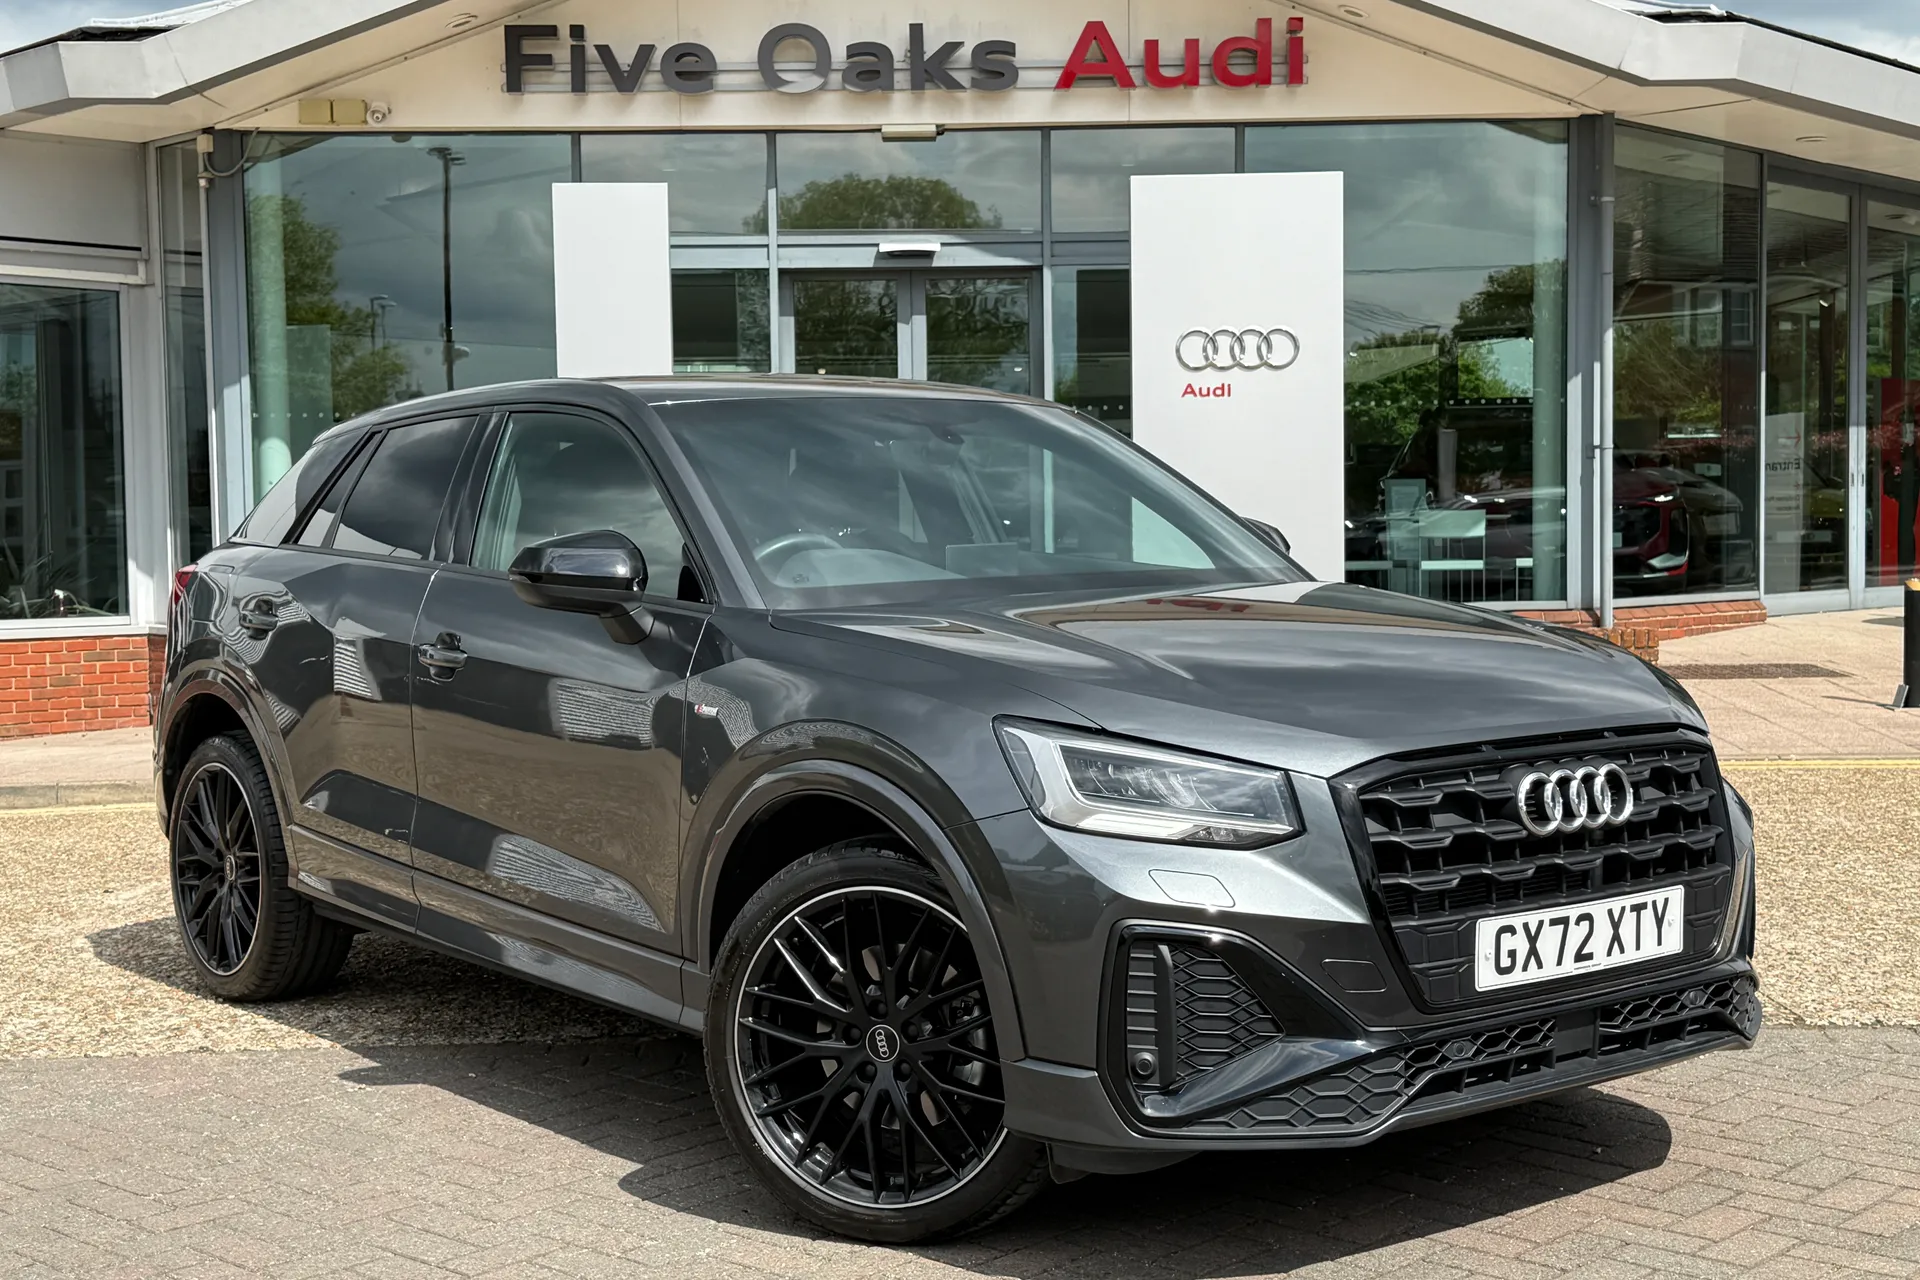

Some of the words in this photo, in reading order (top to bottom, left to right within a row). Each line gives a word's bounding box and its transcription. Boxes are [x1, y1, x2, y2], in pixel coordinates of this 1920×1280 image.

[504, 24, 717, 94] Five
[757, 22, 1018, 93] Oaks
[1053, 17, 1305, 89] Audi
[1181, 383, 1232, 398] Audi
[1494, 912, 1595, 976] GX72
[1606, 897, 1669, 957] XTY
